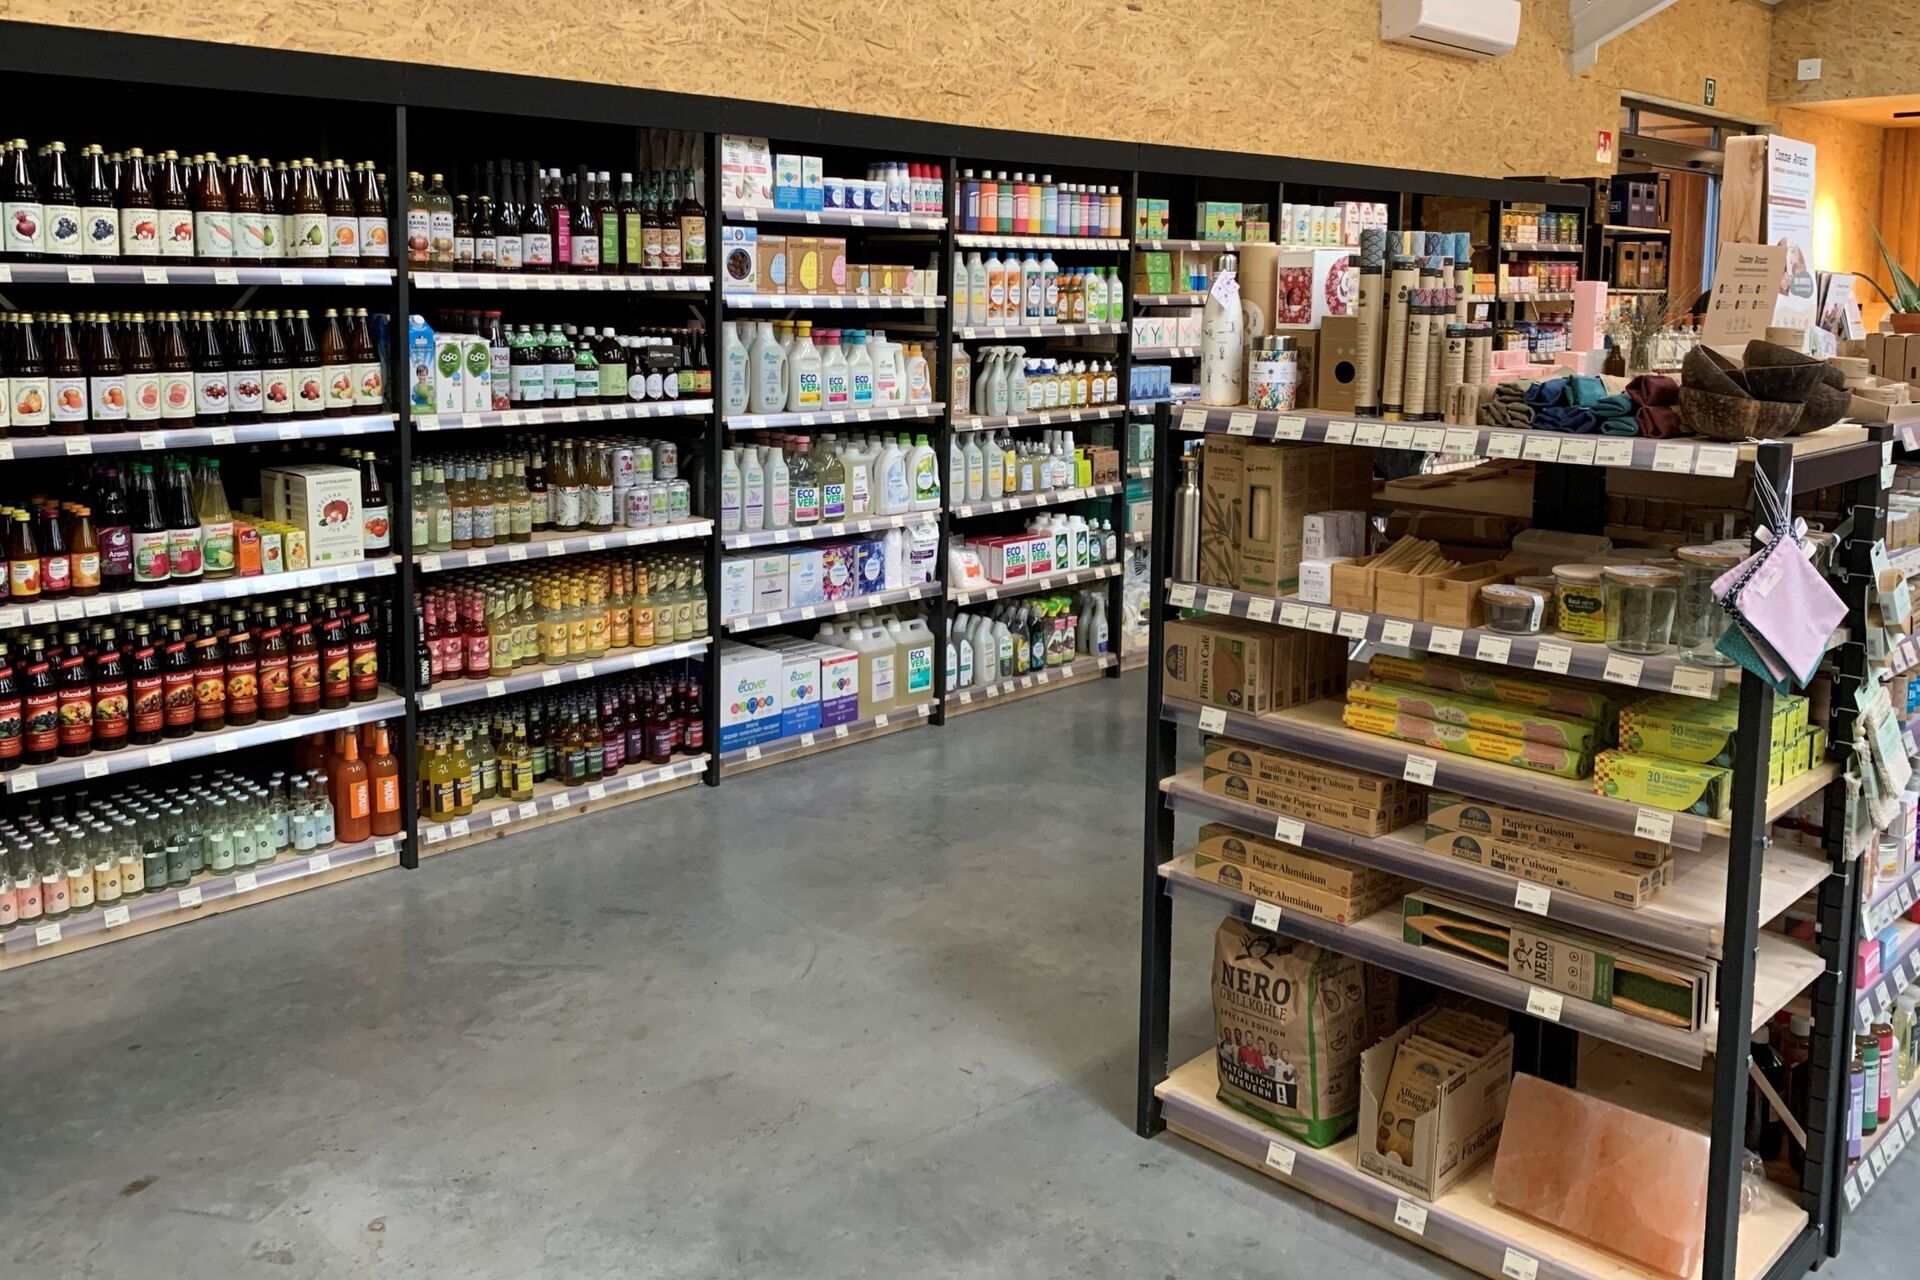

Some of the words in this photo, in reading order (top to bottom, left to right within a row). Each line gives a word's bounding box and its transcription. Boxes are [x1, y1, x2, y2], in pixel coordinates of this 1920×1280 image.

[801, 374, 816, 383] ECO
[829, 377, 843, 385] ECO
[855, 376, 868, 384] ECO
[798, 489, 814, 498] ECO
[826, 486, 840, 495] ECO
[1006, 546, 1021, 557] ECO
[1032, 542, 1046, 552] ECO
[291, 559, 306, 568] BIO
[1200, 635, 1210, 655] Café
[911, 650, 925, 660] ECO
[738, 678, 768, 693] ecover
[1200, 664, 1210, 699] Filtres
[1670, 723, 1684, 737] 30
[1260, 760, 1284, 778] Feuilles
[1298, 770, 1322, 789] Papier
[1322, 775, 1354, 793] Cuisson
[1647, 770, 1661, 784] 30
[1256, 786, 1281, 804] Feuilles
[1294, 796, 1317, 814] Papier
[1318, 802, 1348, 820] Cuisson
[1502, 817, 1534, 834] Papier
[1535, 823, 1575, 840] Cuisson
[1253, 854, 1278, 873] Papier
[1279, 861, 1327, 886] Aluminium
[1491, 848, 1522, 866] Papier
[1522, 855, 1558, 875] Cuisson
[1249, 881, 1275, 900] Papier
[1275, 890, 1324, 915] Aluminium
[1535, 940, 1548, 982] NERO
[1221, 960, 1291, 1006] NERO
[1251, 1019, 1286, 1038] EDITION
[1222, 1059, 1274, 1090] NATÜRLICH
